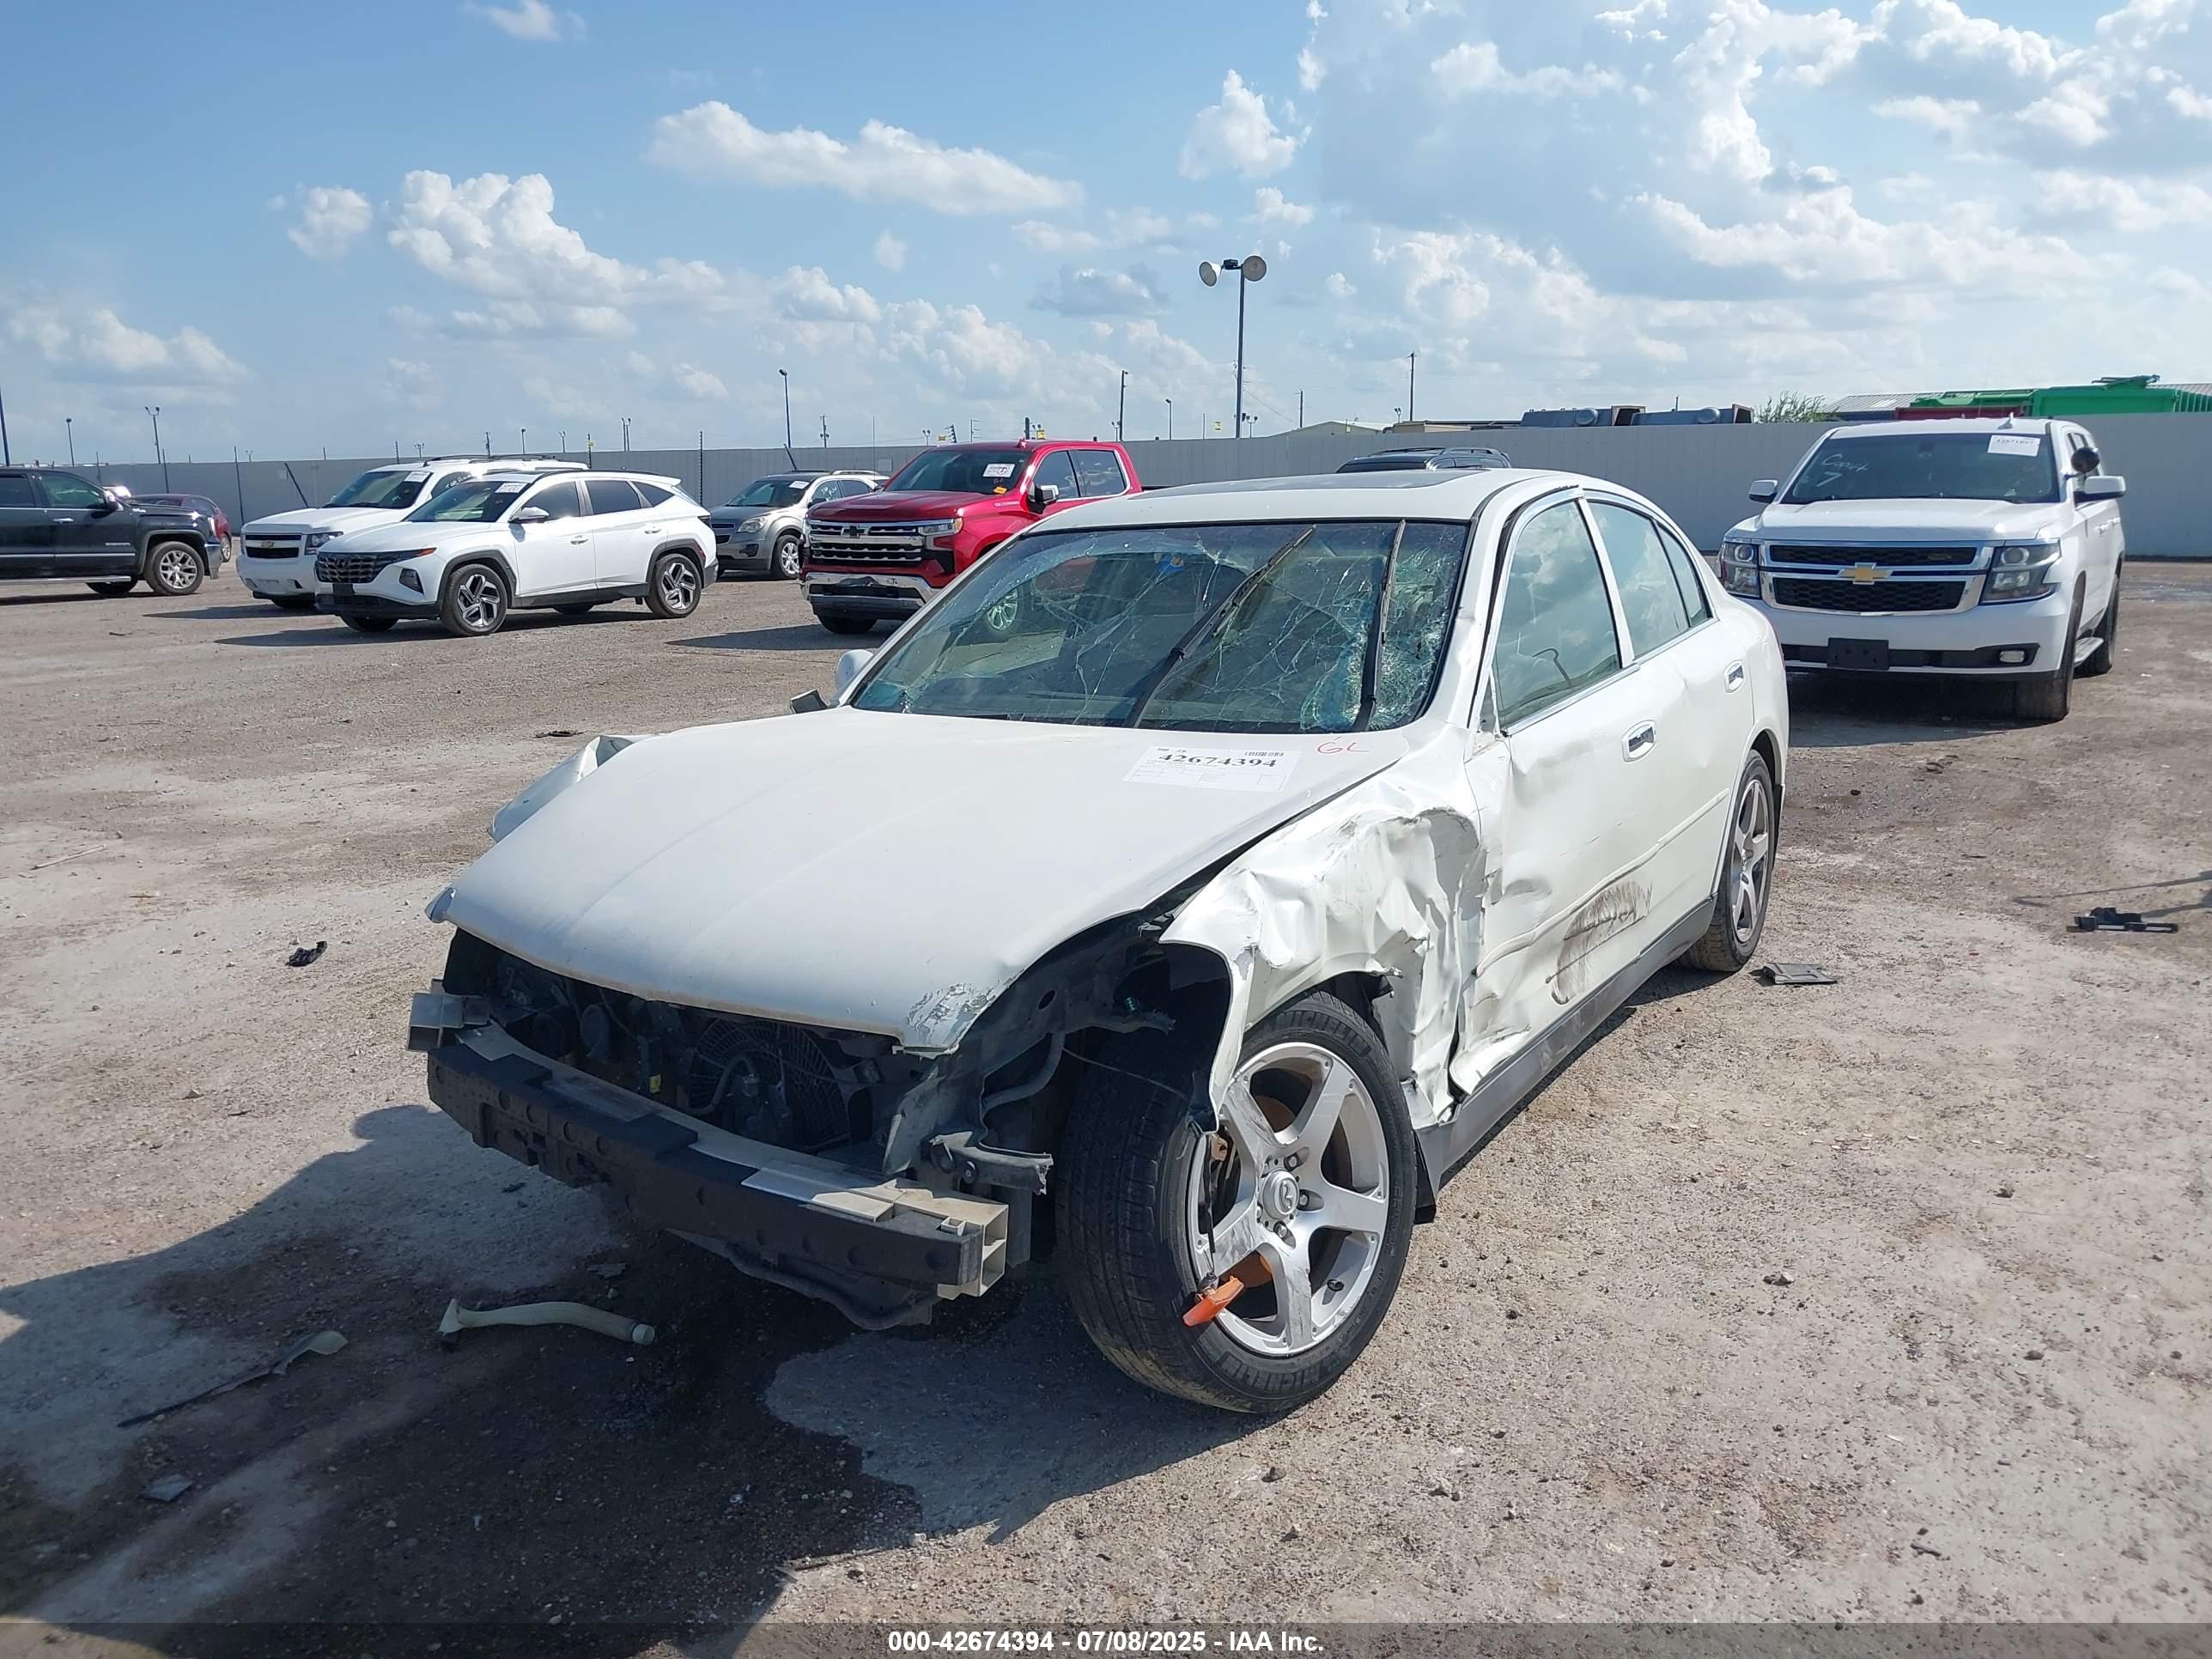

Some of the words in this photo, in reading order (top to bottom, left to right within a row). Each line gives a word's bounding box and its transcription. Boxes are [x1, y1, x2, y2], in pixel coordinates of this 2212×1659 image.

[1158, 754, 1277, 768] 42674394
[1276, 1011, 1370, 1056] MICHELIN
[1223, 1354, 1321, 1390] MICHELIN
